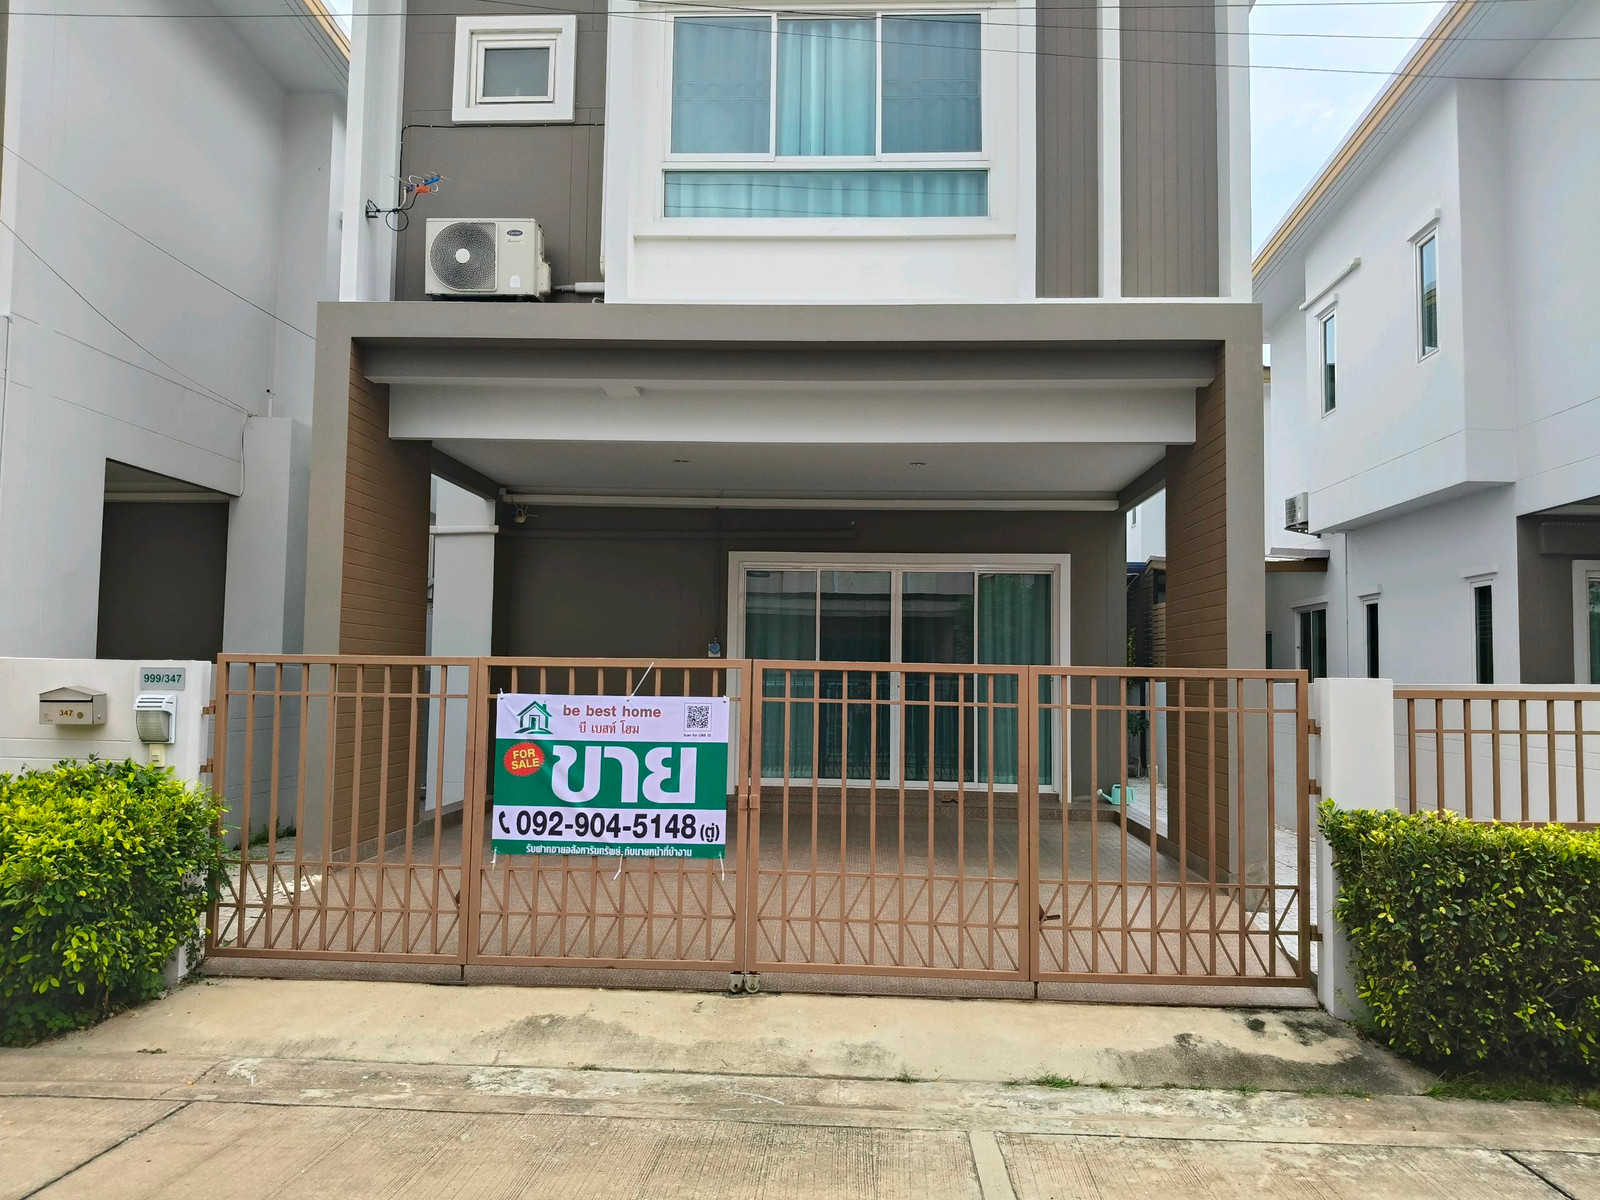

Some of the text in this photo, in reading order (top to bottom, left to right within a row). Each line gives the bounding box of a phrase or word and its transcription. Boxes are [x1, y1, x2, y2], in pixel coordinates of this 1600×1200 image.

[143, 673, 182, 684] 999/347
[59, 709, 73, 717] 347
[563, 705, 662, 718] be best home
[578, 720, 640, 735] บี เบสท์ โฮม
[512, 748, 536, 760] FOR
[511, 758, 540, 770] SALE
[551, 744, 698, 804] ขาย
[516, 810, 720, 843] 092-904-5148 (ตู่)
